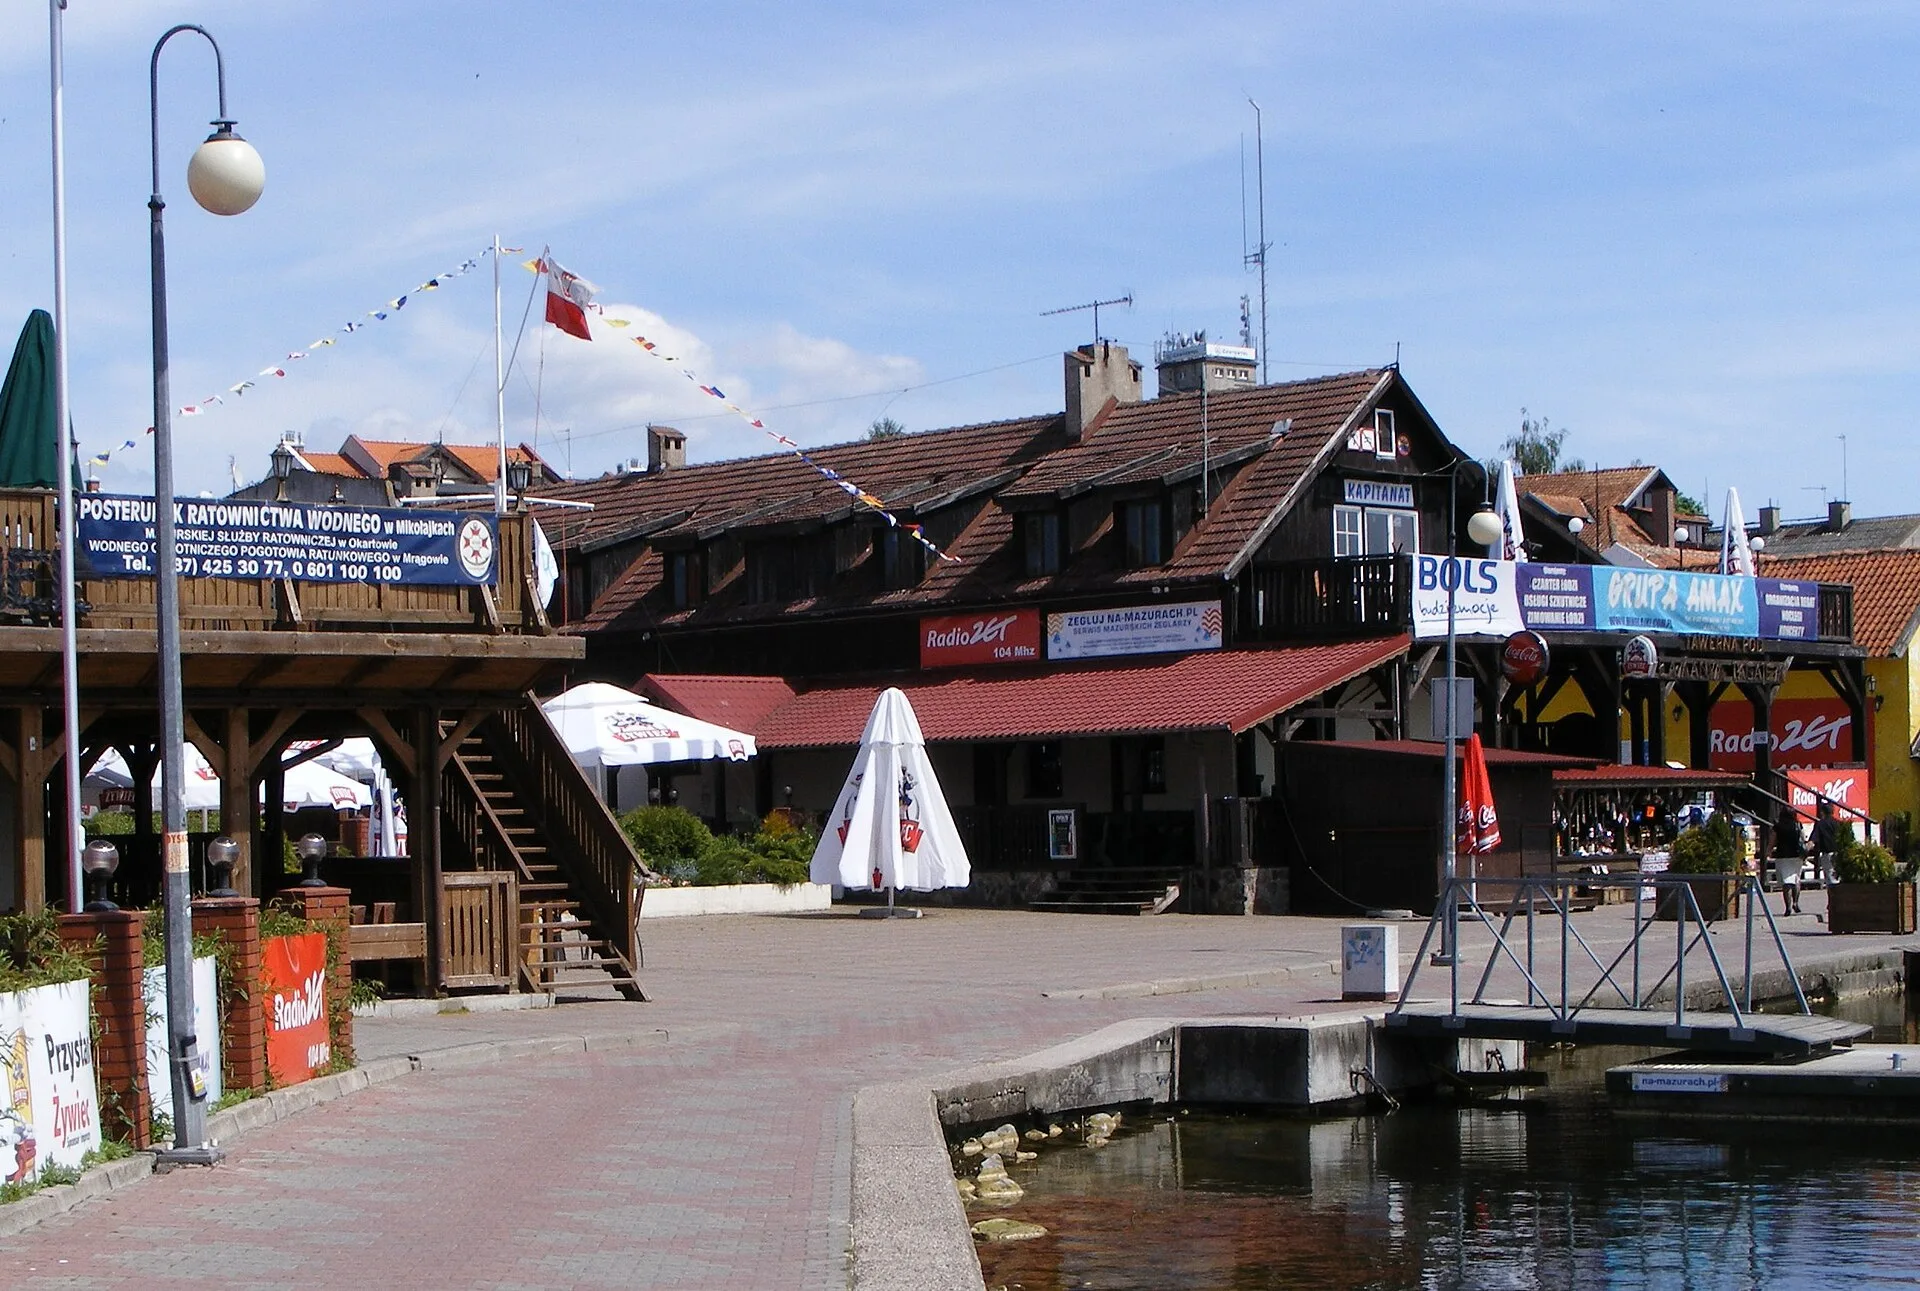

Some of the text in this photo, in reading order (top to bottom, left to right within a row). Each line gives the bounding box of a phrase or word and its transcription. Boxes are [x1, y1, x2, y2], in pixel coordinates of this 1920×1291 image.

[1347, 482, 1412, 503] KAPITANAT
[80, 499, 456, 539] POSTERUK RATOWNICTWA WODNEGO w Mikołajkach
[145, 527, 399, 552] MRSKIEJ SŁUŻBY RATOWNICZEJ w Okartowie
[89, 540, 149, 553] WODNEGO
[240, 546, 308, 560] POGOTOWIA
[308, 549, 391, 564] RATUNKOWEGO
[392, 554, 402, 564] w
[403, 553, 450, 568] Mrągowie
[122, 554, 152, 571] Tel.
[202, 559, 233, 575] 425
[237, 560, 259, 575] 30
[263, 561, 289, 577] 77,
[292, 562, 303, 577] 0
[306, 562, 334, 578] 601
[339, 564, 368, 580] 100
[373, 566, 402, 581] 100
[1418, 557, 1498, 594] BOLS
[1608, 571, 1745, 615] GRUPA AMAX
[993, 646, 1036, 659] 104 Mhz
[1685, 636, 1740, 652] TAWERNA
[1642, 1077, 1718, 1089] na-mazurach.pl
